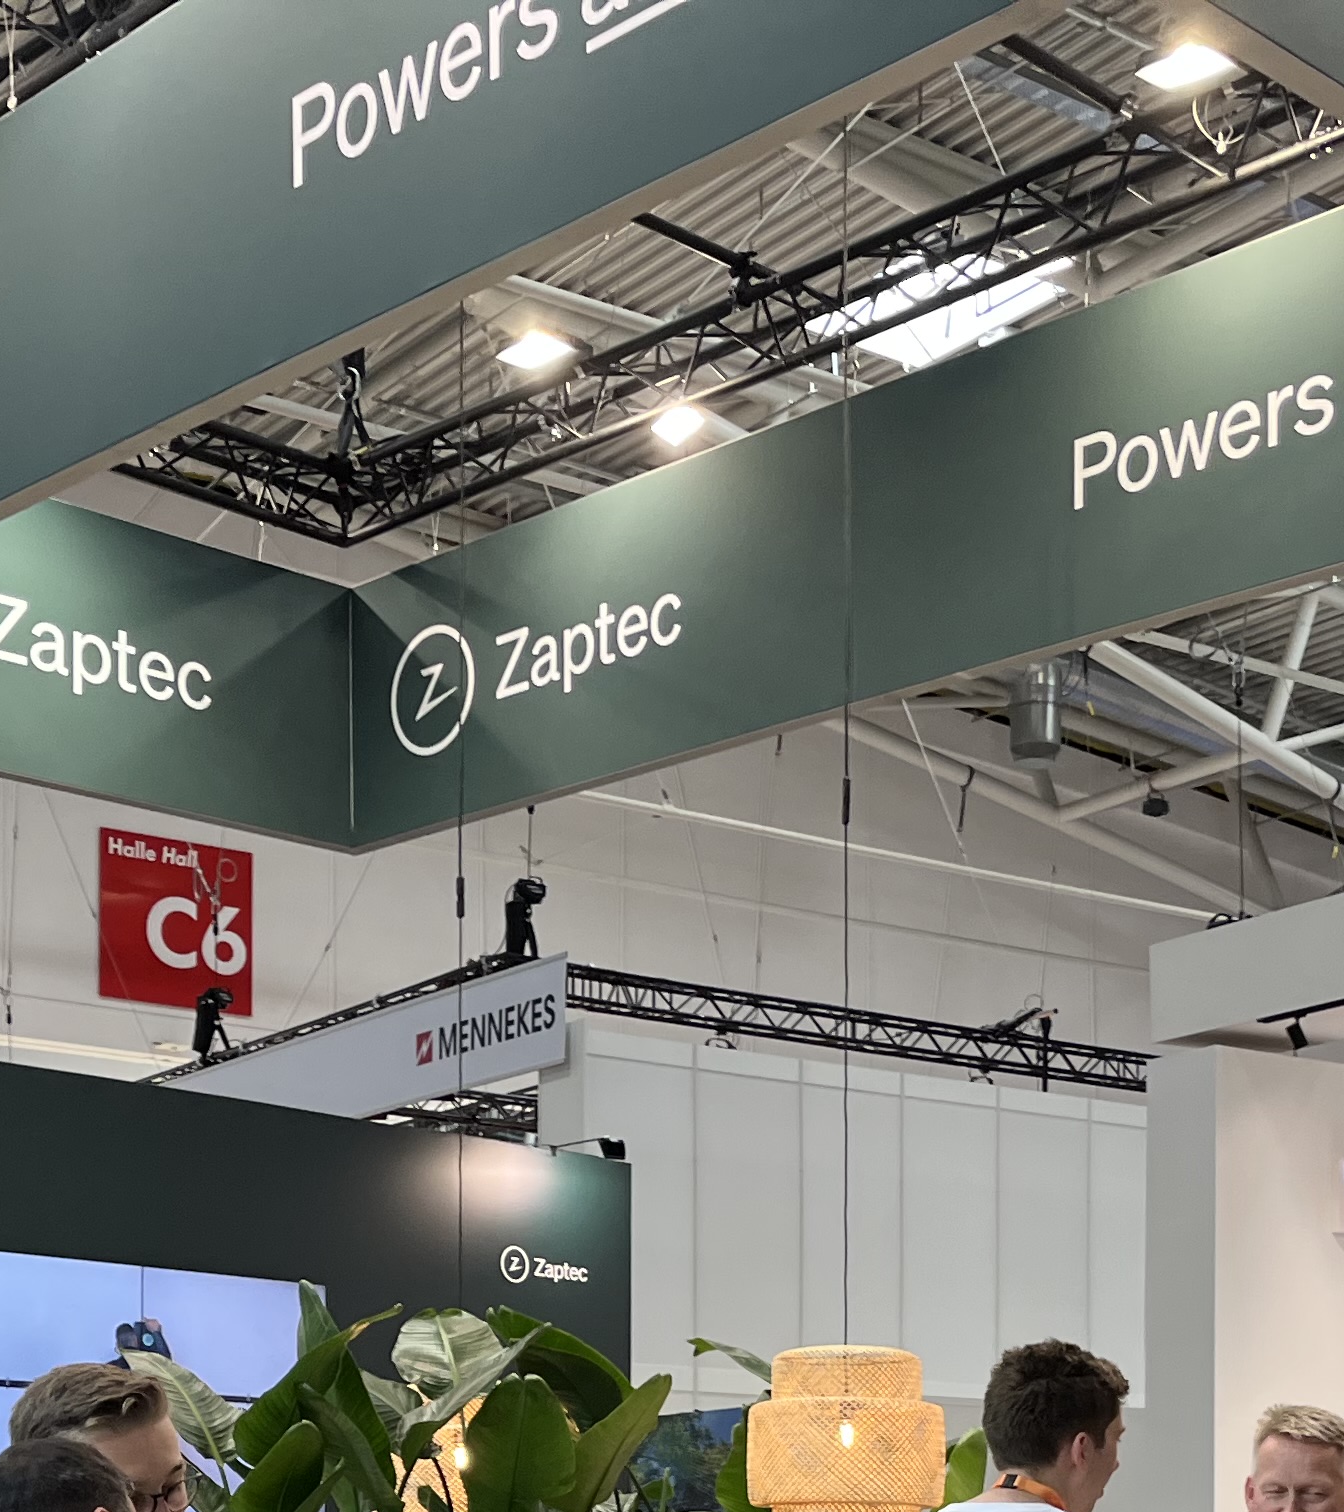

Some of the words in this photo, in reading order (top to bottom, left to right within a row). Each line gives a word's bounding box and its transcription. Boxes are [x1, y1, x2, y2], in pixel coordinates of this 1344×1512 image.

[291, 0, 558, 188] Powers
[1072, 373, 1335, 511] Powers
[495, 593, 682, 700] Zaptec
[108, 836, 157, 862] Halle
[161, 846, 199, 868] Hall
[146, 896, 248, 976] C6
[439, 994, 556, 1060] MENNEKES
[533, 1257, 589, 1283] Zaptec
